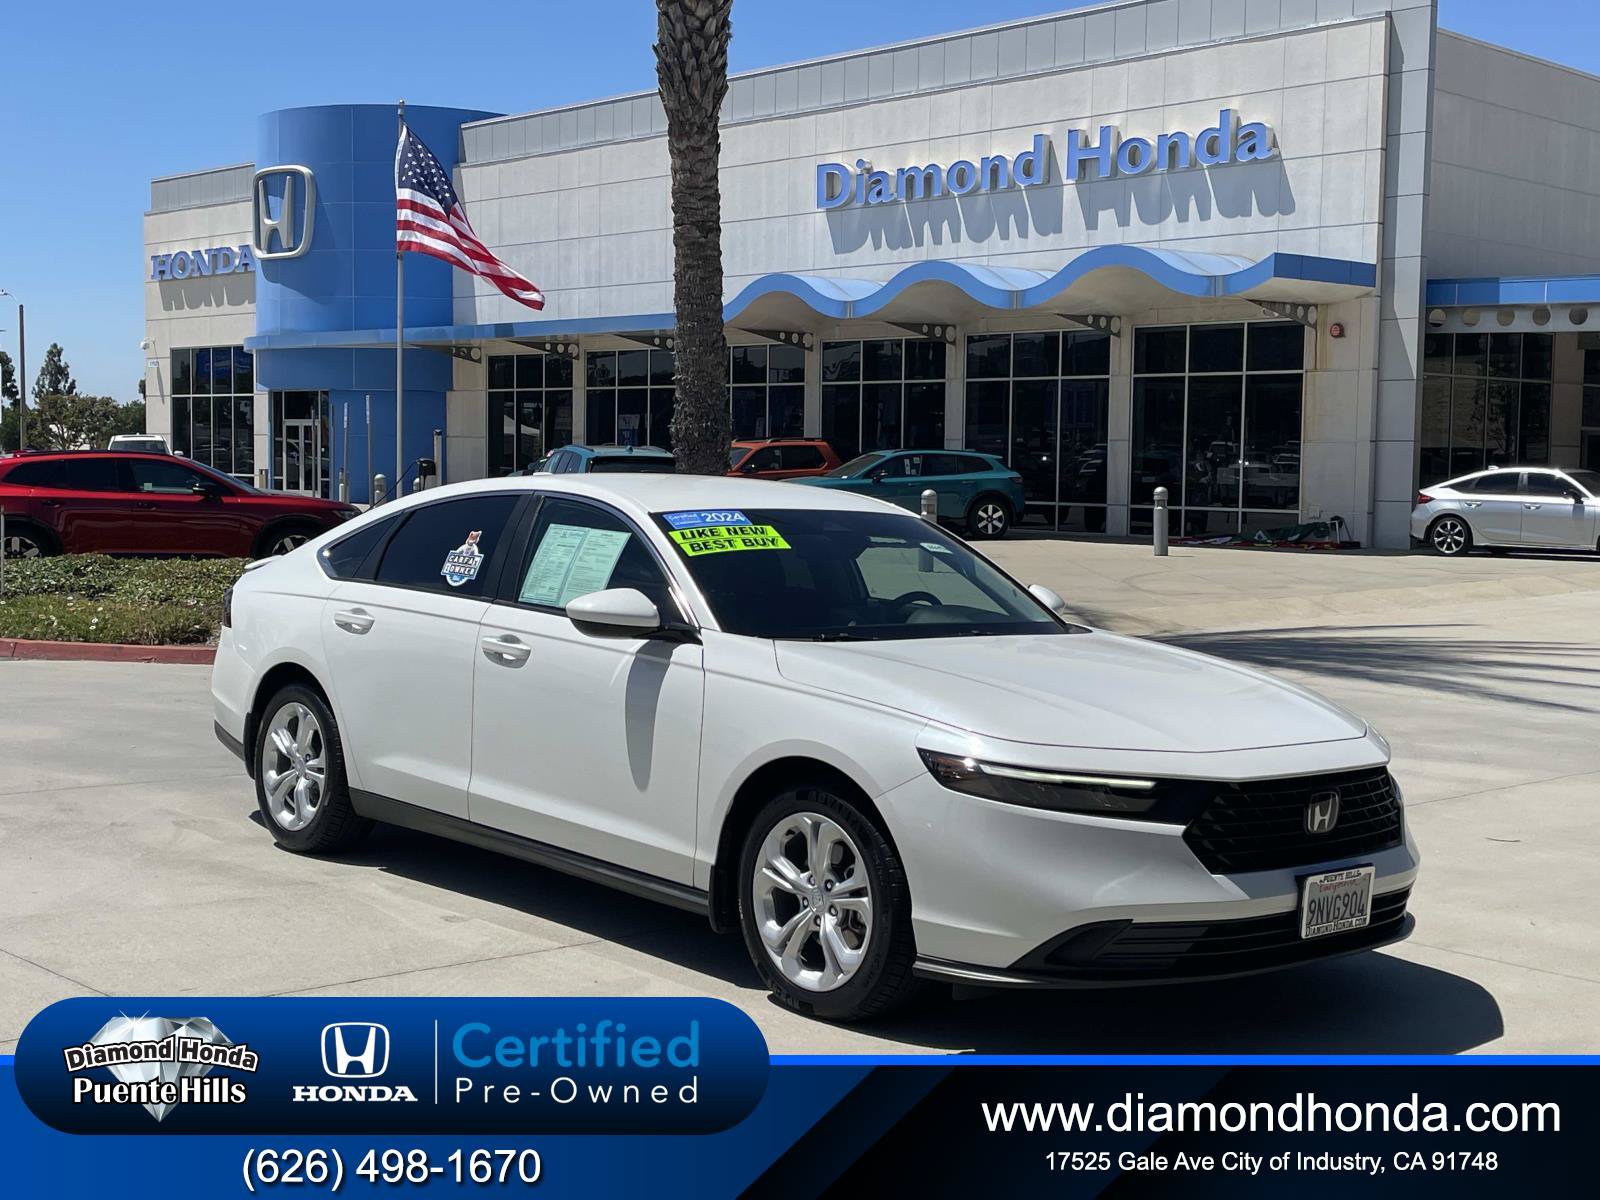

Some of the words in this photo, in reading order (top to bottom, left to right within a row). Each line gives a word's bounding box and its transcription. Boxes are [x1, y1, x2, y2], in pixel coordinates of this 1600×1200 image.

[816, 132, 1051, 210] Diamond
[1067, 107, 1280, 181] Honda
[150, 245, 256, 281] HONDA
[701, 512, 746, 523] 2024
[680, 527, 721, 541] LIKE
[725, 525, 767, 537] NEW
[689, 539, 736, 552] BEST
[743, 537, 778, 547] BUY
[450, 564, 476, 576] OWNER
[1308, 890, 1365, 926] 9NVG904
